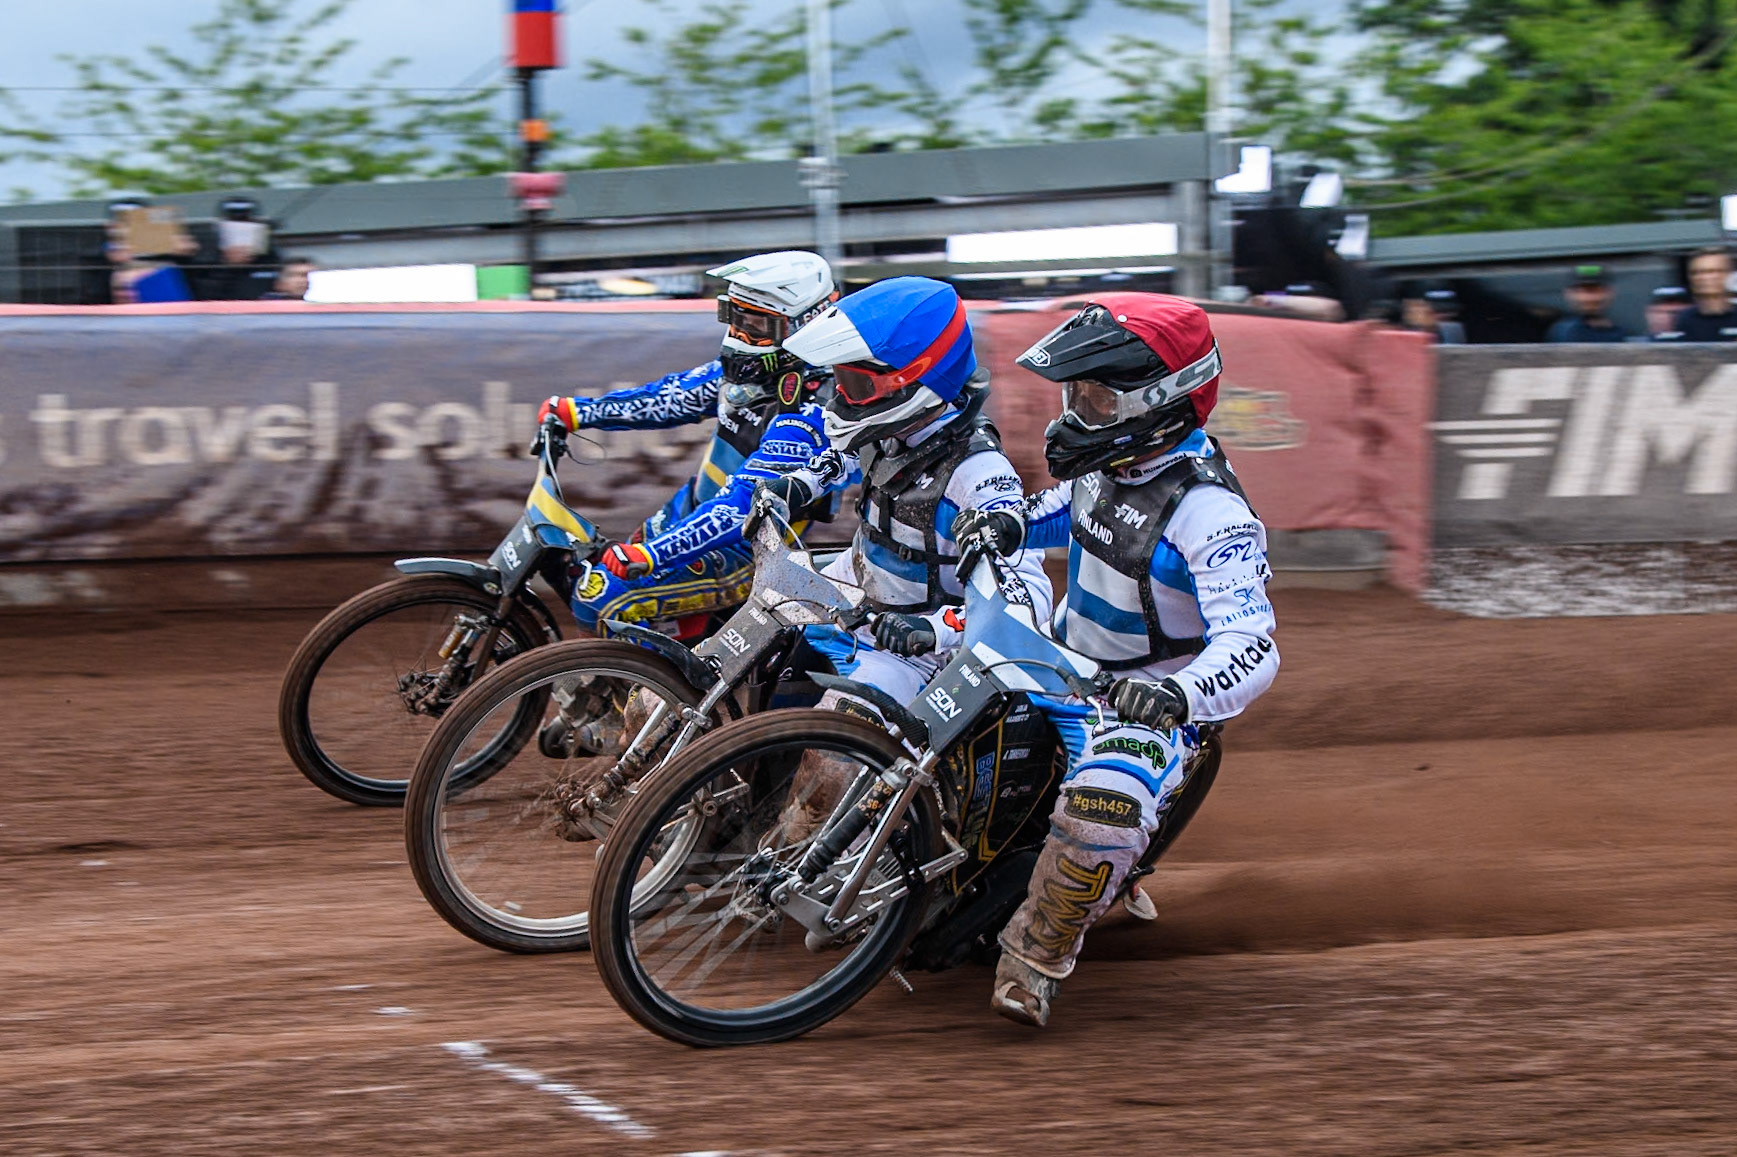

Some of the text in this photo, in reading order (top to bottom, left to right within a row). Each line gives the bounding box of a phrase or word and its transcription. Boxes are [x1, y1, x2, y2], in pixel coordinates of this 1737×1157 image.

[28, 381, 339, 467] travel
[1428, 364, 1737, 499] FIM
[1078, 508, 1114, 545] FINLAND
[1114, 503, 1149, 530] FIM
[723, 628, 751, 653] SON
[959, 664, 981, 688] FINLAND
[930, 687, 963, 719] SON
[1072, 794, 1132, 816] #gsh457
